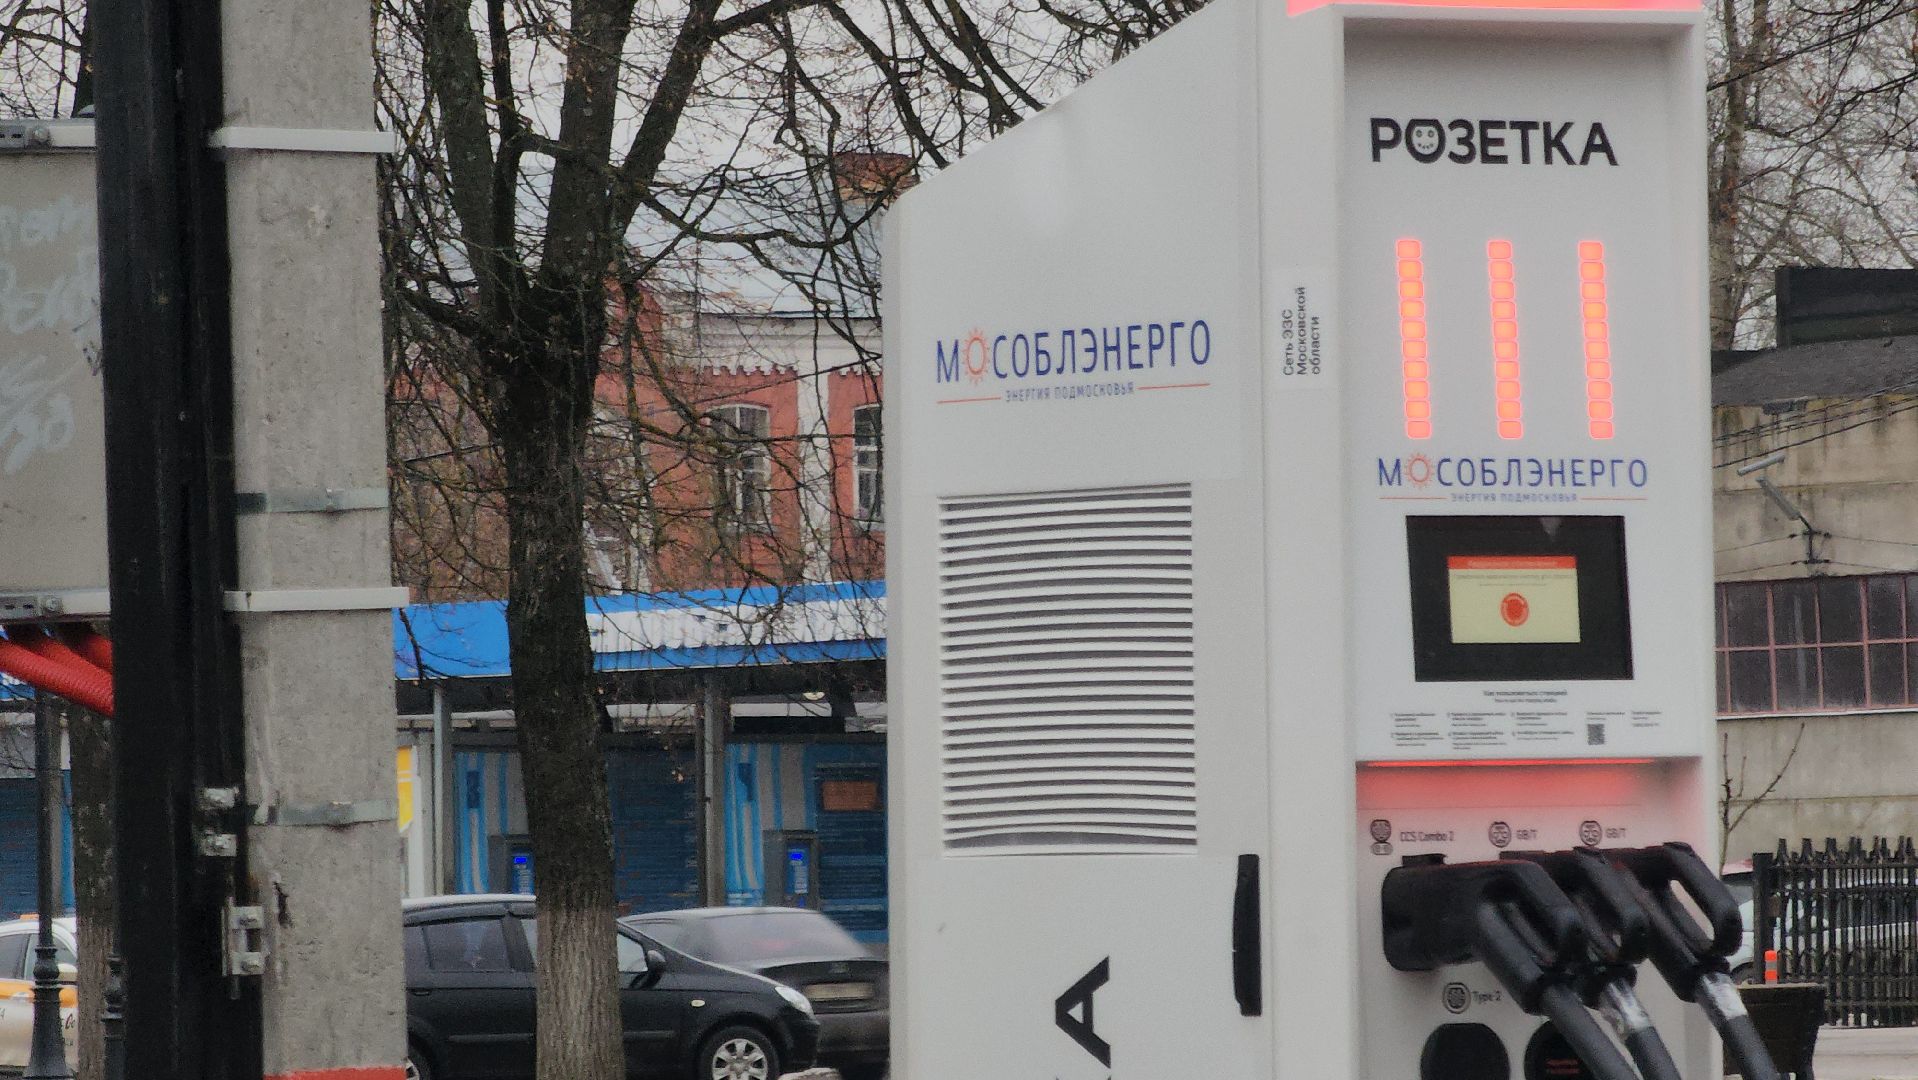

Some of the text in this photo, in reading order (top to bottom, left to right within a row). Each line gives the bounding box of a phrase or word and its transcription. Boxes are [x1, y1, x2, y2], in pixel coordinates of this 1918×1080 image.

[1370, 118, 1620, 166] РОЗЕТКА
[937, 319, 1211, 385] МОСОБЛЭНЕРГО
[1282, 309, 1294, 376] Сеть ЭЗС
[1295, 286, 1307, 375] Московской
[1309, 316, 1321, 375] области
[1005, 381, 1135, 402] ЭНЕРГИЯ ПОДМОСКОВЬЯ
[1378, 454, 1648, 488] МОСОБЛЭНЕРГО
[1451, 493, 1497, 503] ЭНЕРГИЯ
[1055, 956, 1111, 1080] А
